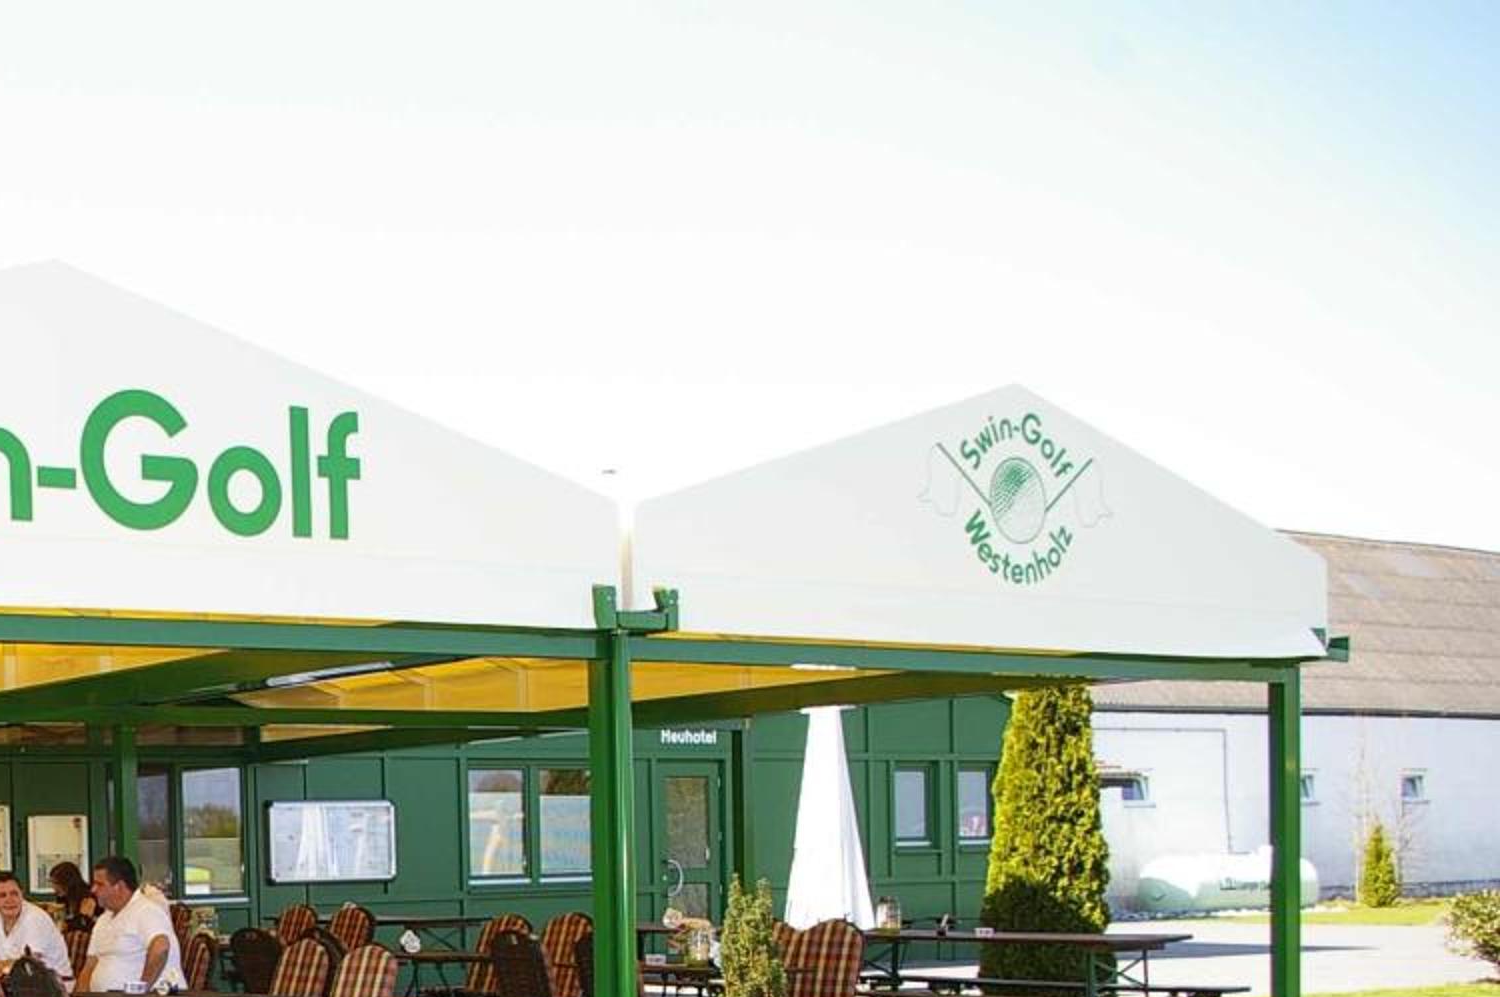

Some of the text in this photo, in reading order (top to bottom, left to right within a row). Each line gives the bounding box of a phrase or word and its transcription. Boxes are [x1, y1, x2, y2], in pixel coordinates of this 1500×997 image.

[959, 412, 1074, 477] Swin-Golf
[964, 509, 1073, 585] Westenholz
[660, 727, 717, 745] Heuhotel
